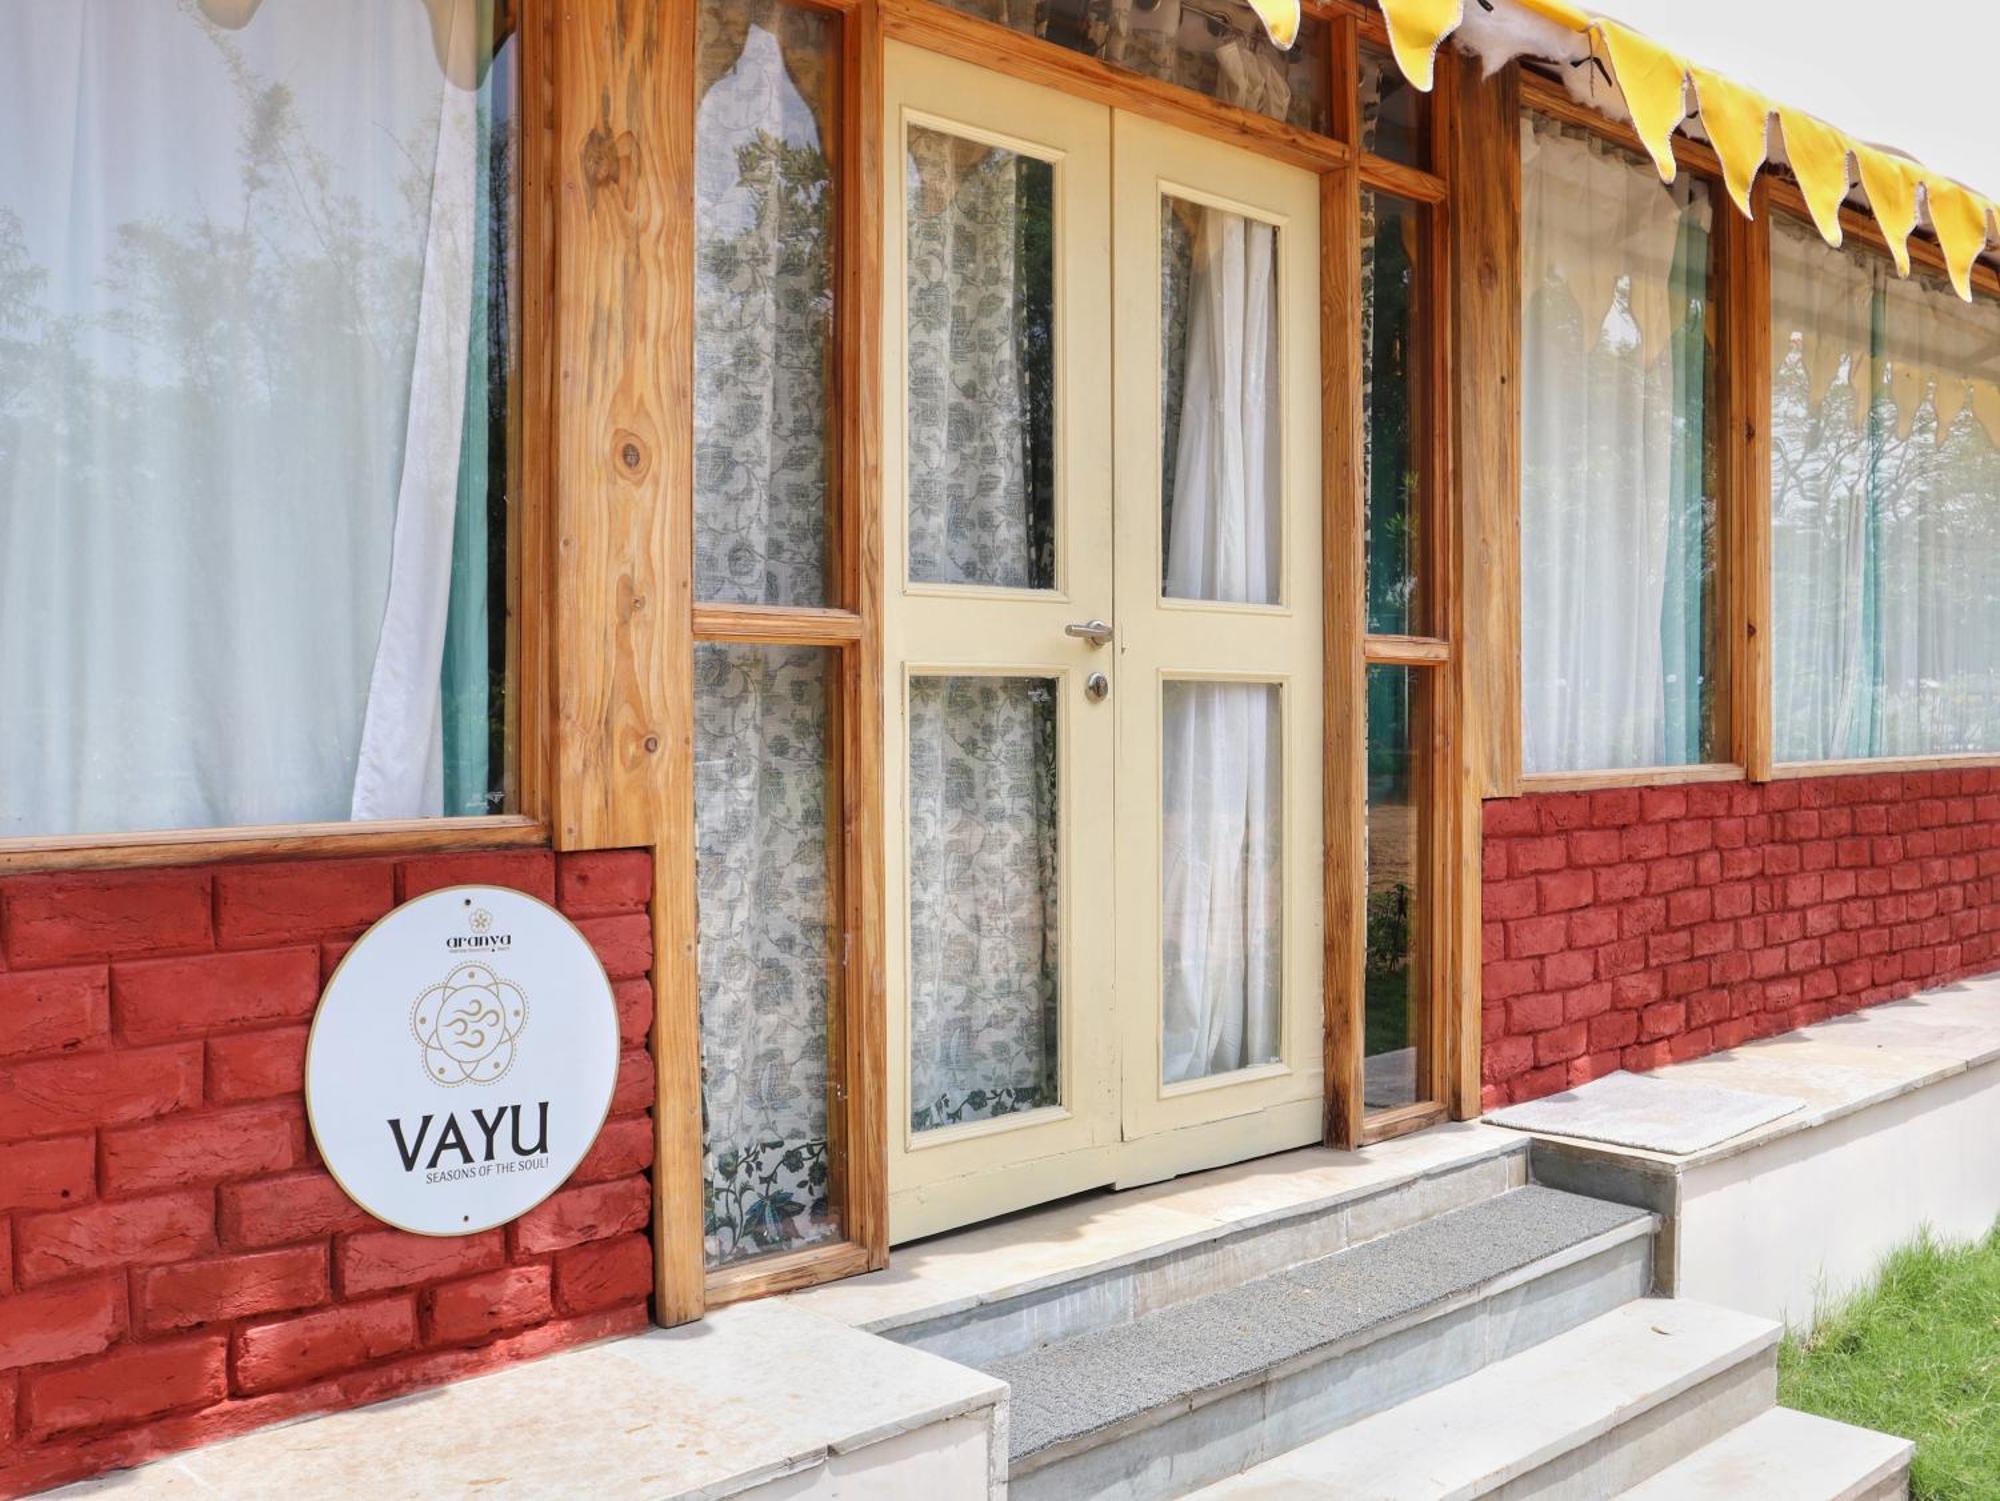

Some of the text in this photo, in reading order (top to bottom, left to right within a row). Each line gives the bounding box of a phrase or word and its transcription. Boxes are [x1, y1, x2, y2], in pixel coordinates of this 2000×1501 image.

[446, 934, 512, 952] aranya
[387, 1101, 549, 1172] VAYU
[426, 1156, 549, 1185] SEASONS OF THE SOUL!
